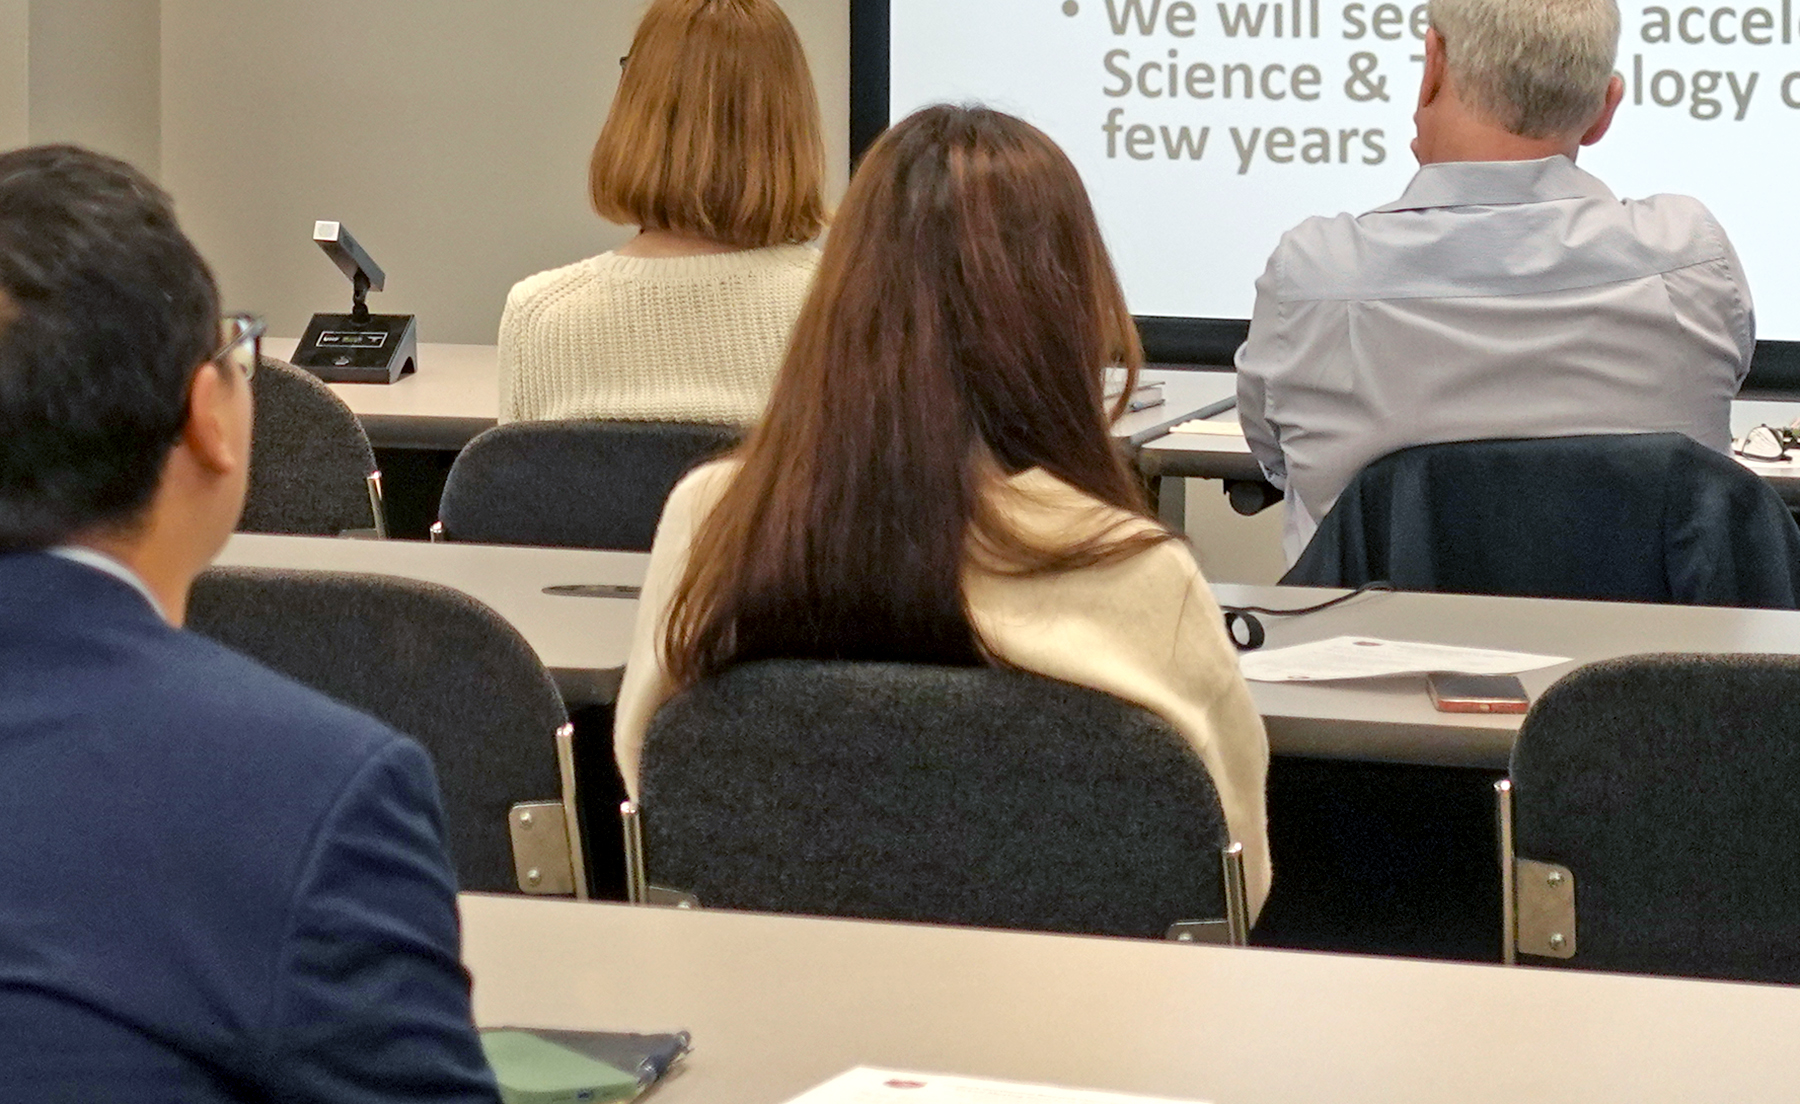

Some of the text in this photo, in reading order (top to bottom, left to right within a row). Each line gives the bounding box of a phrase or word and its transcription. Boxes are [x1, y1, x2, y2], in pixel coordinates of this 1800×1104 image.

[1103, 49, 1321, 101] Science
[1344, 51, 1389, 102] &
[1102, 108, 1386, 175] few years
